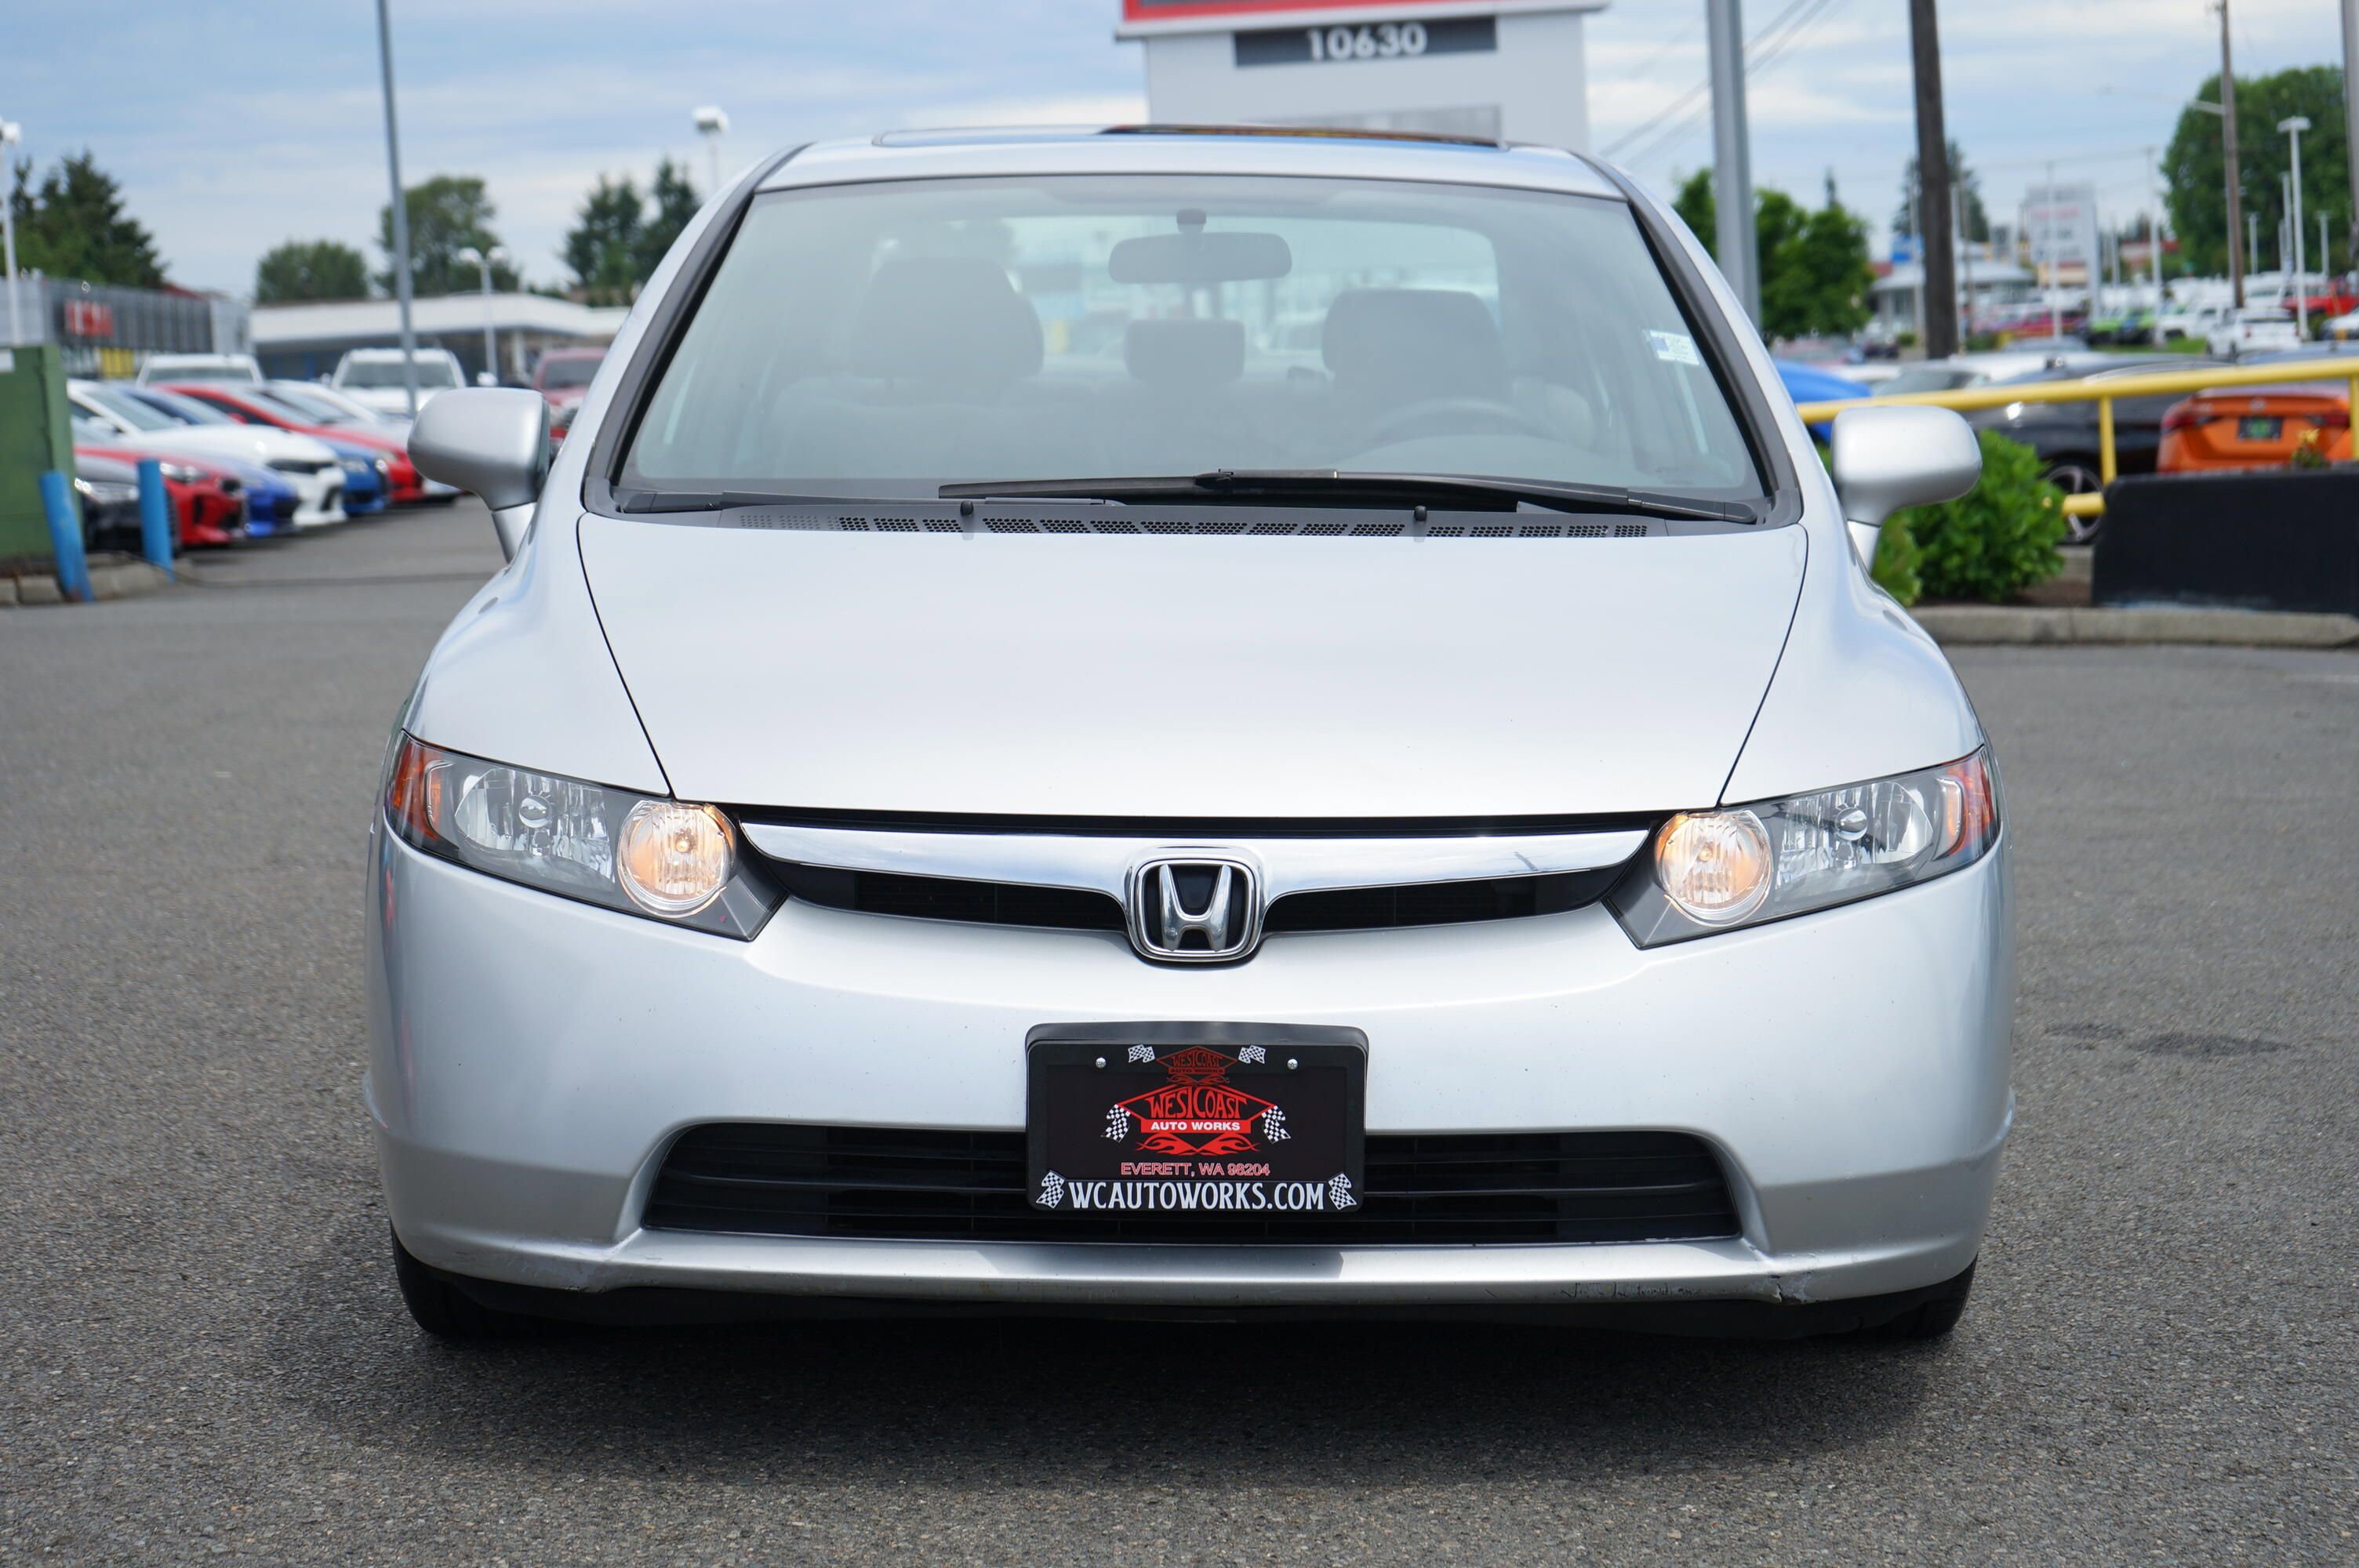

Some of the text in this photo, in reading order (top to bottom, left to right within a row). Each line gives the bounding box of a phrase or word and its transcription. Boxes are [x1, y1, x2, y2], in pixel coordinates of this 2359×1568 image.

[1307, 23, 1428, 60] 10630
[1150, 1122, 1241, 1131] AUTO WORKS
[1121, 1163, 1270, 1177] EVERETT, WA 98204
[1068, 1182, 1325, 1210] WCAUTOWORKS.COM
